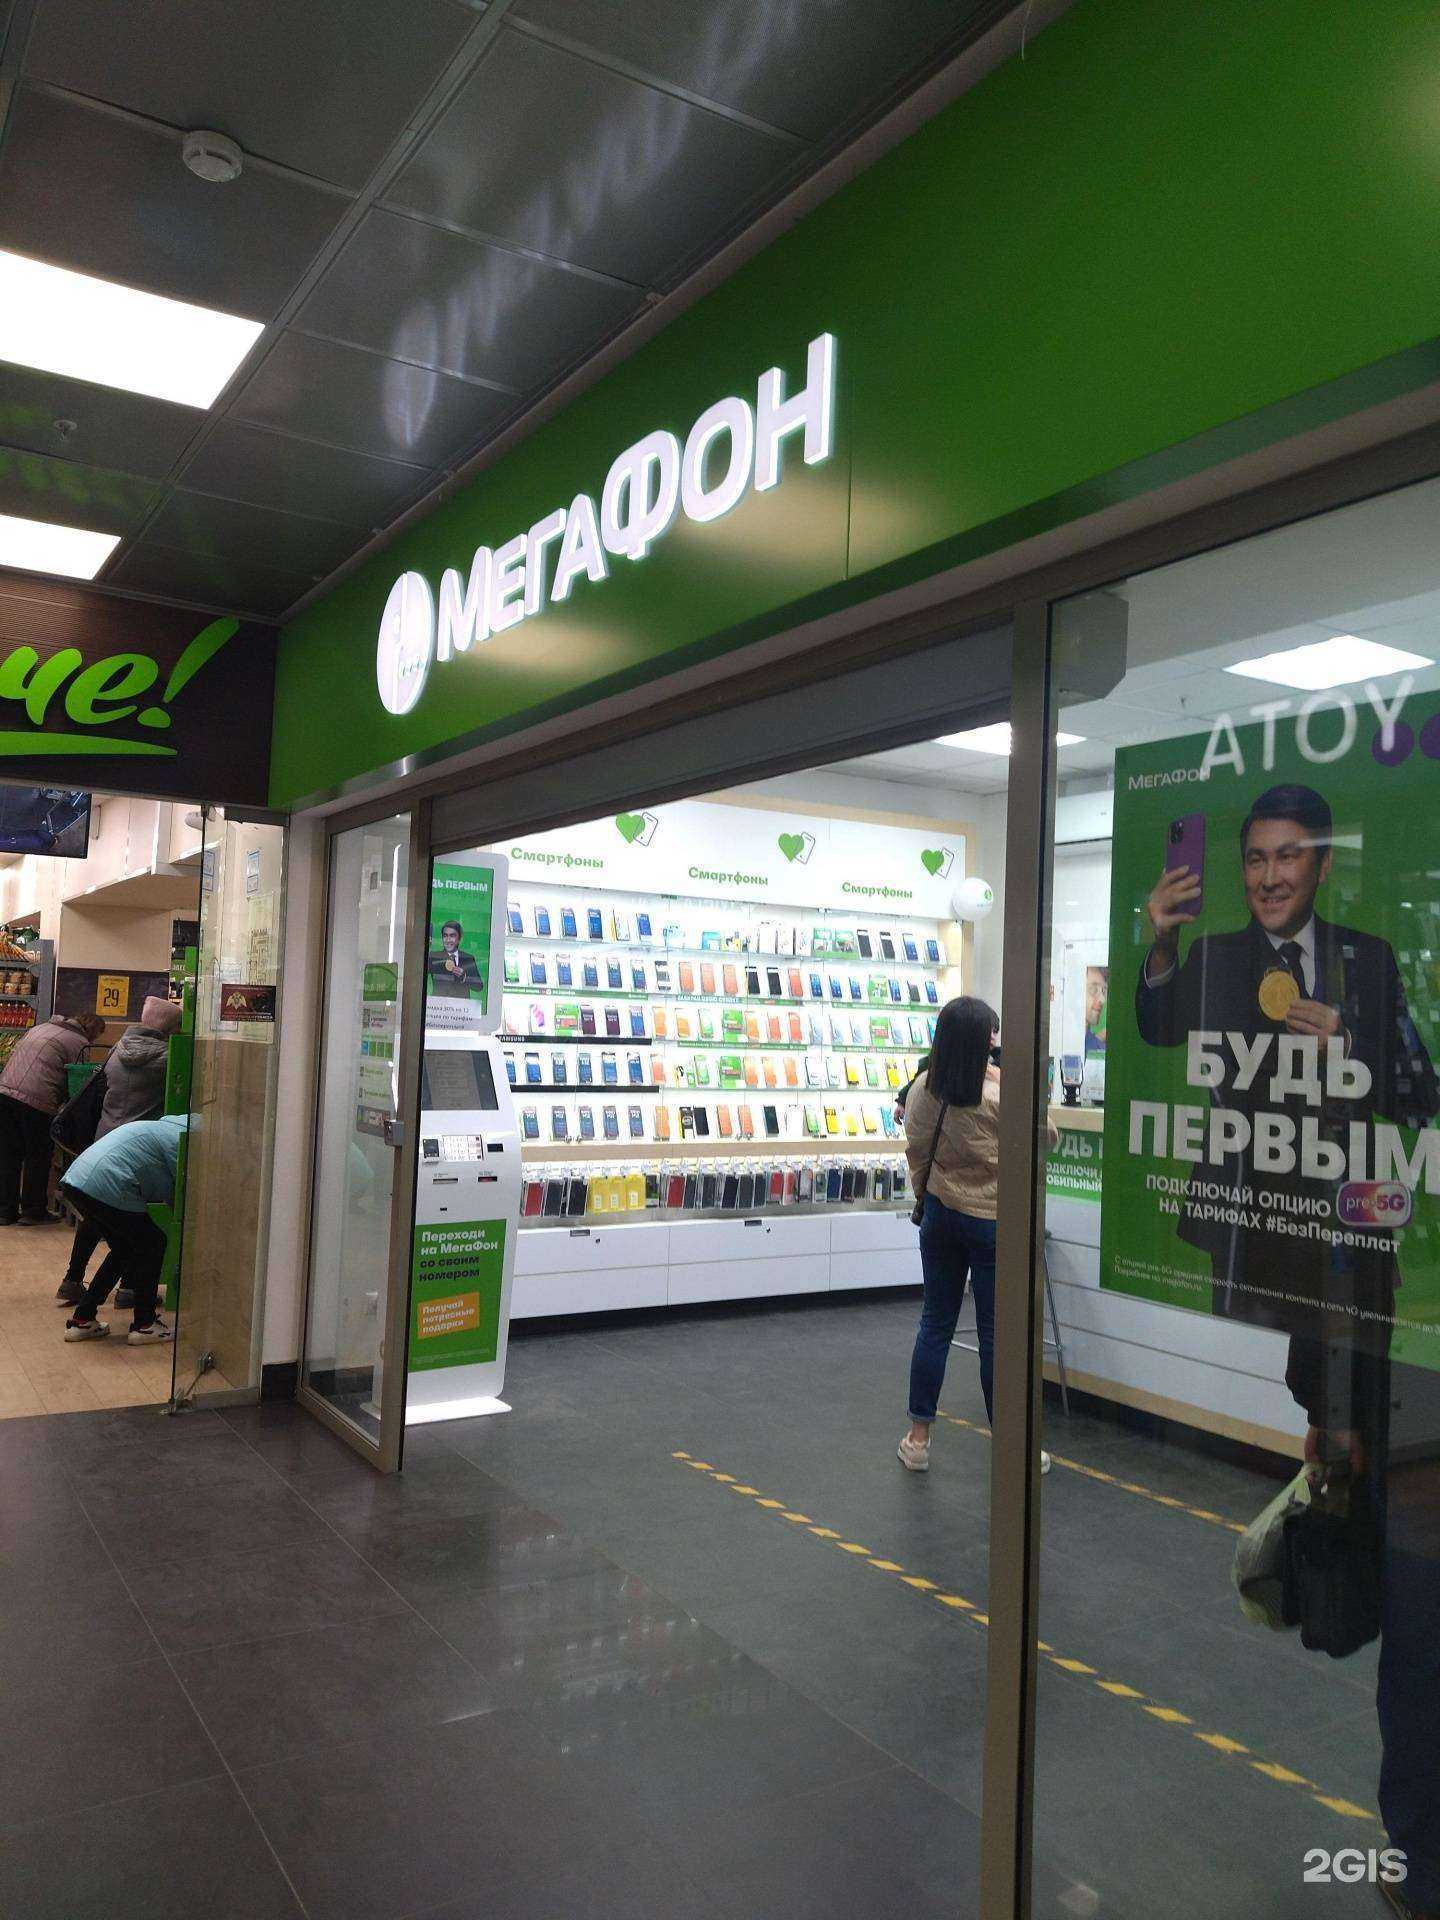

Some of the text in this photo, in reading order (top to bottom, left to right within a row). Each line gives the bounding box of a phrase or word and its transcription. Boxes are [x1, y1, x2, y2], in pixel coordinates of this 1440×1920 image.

[436, 331, 837, 662] МЕГАФОН
[511, 846, 604, 869] Смартфоны
[445, 879, 488, 892] ПЕРВЫМ
[688, 866, 769, 886] Смартфоны
[842, 882, 913, 900] Смартфоны
[103, 988, 119, 1007] 29
[1187, 1030, 1372, 1107] БУДЬ
[1129, 1100, 1440, 1195] ПЕРВЫМ
[1145, 1174, 1253, 1203] ПОДКЛЮЧАЙ
[1258, 1190, 1331, 1218] ОПЦИЮ
[1159, 1197, 1400, 1254] НА ТАРИФАХ #БезПереплат
[421, 1228, 485, 1243] Переходи
[420, 1240, 498, 1256] на МегаФон
[419, 1256, 480, 1268] со своим
[418, 1269, 480, 1283] номером
